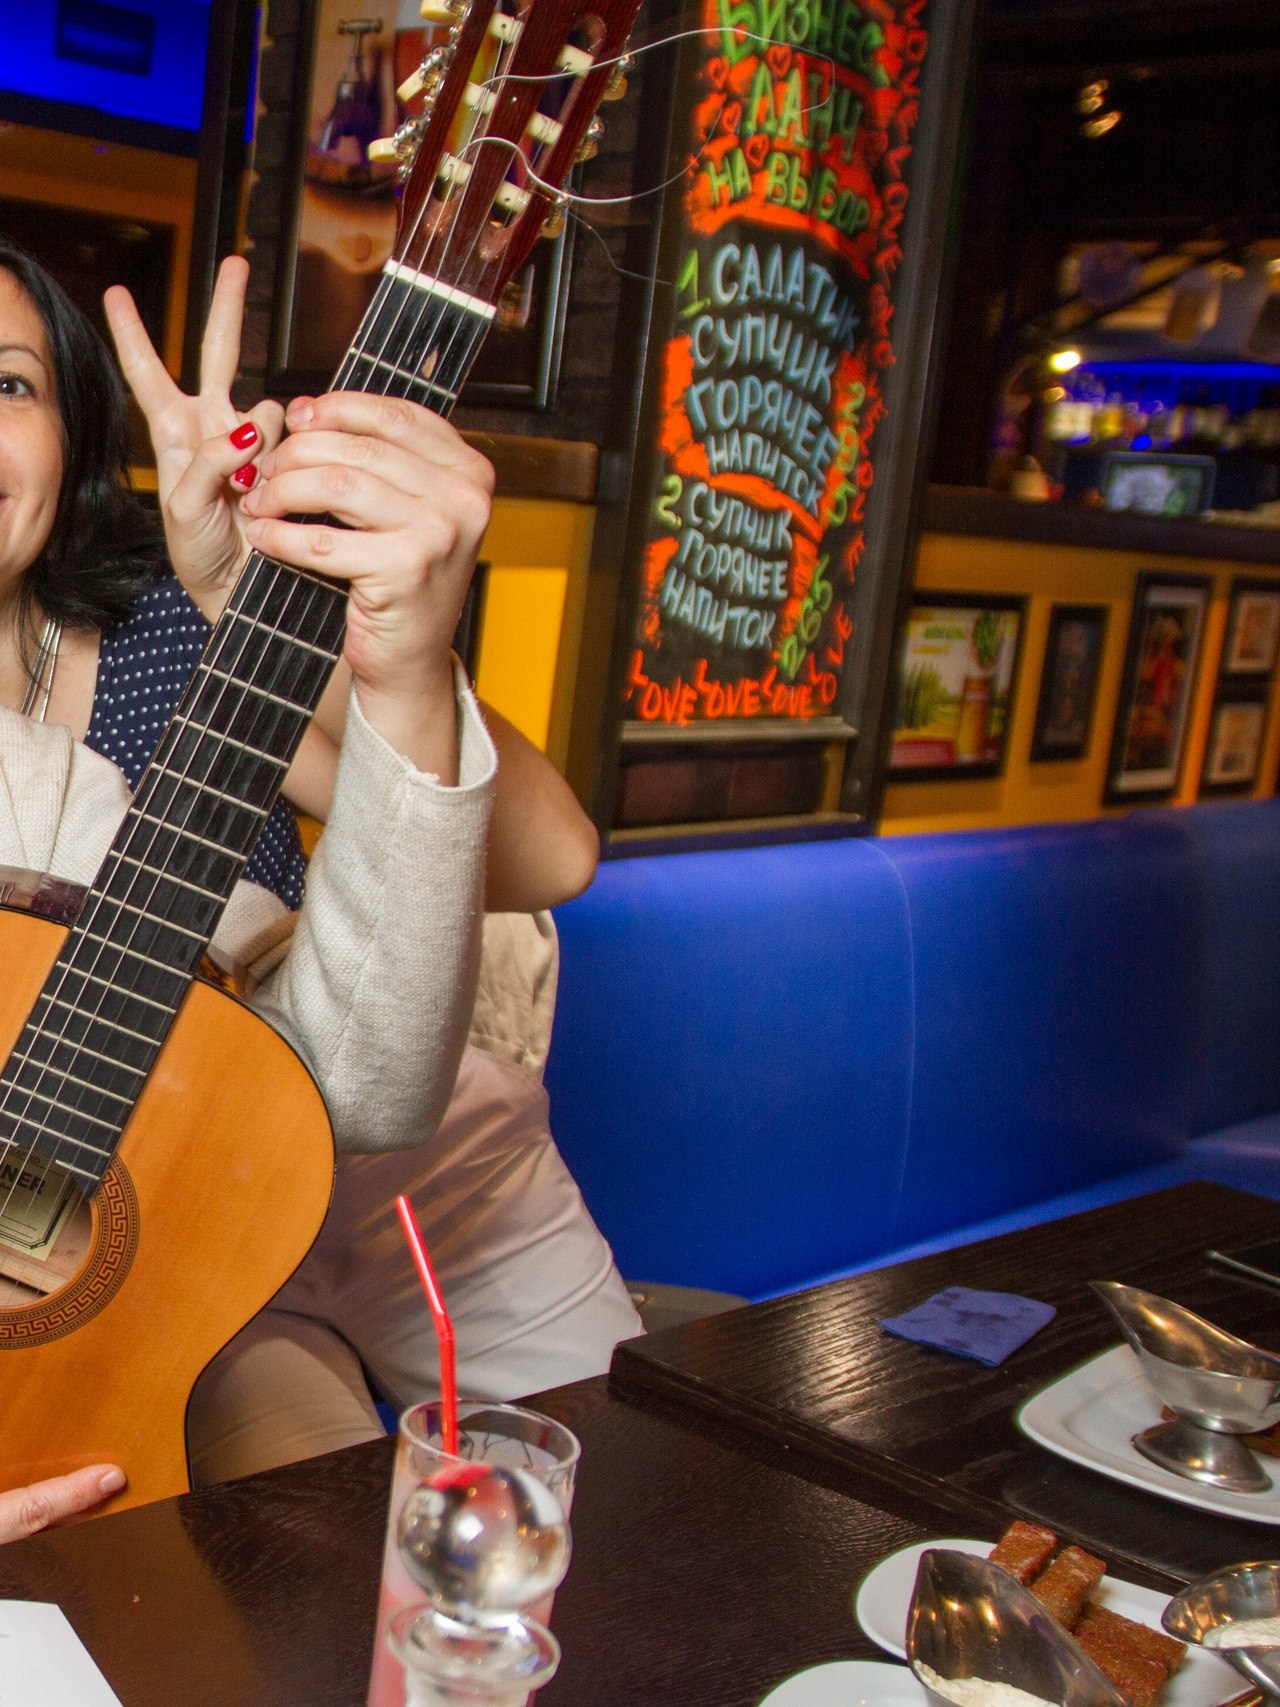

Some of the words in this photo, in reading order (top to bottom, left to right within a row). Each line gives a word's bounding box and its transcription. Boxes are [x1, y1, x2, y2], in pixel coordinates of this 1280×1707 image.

[706, 147, 753, 205] НА
[766, 151, 870, 235] ВЫБОР
[692, 312, 837, 406] СУПЧИК
[687, 375, 840, 485] ГОРЯЧЕЕ
[706, 427, 823, 518] НАПИТОК
[688, 481, 793, 551] СУПЧИК
[678, 528, 789, 600] ГОРЯЧЕЕ
[660, 566, 777, 650] НАПИТОК
[630, 648, 698, 727] LOVE
[695, 657, 761, 718] LOVE
[760, 664, 815, 723] LOVE
